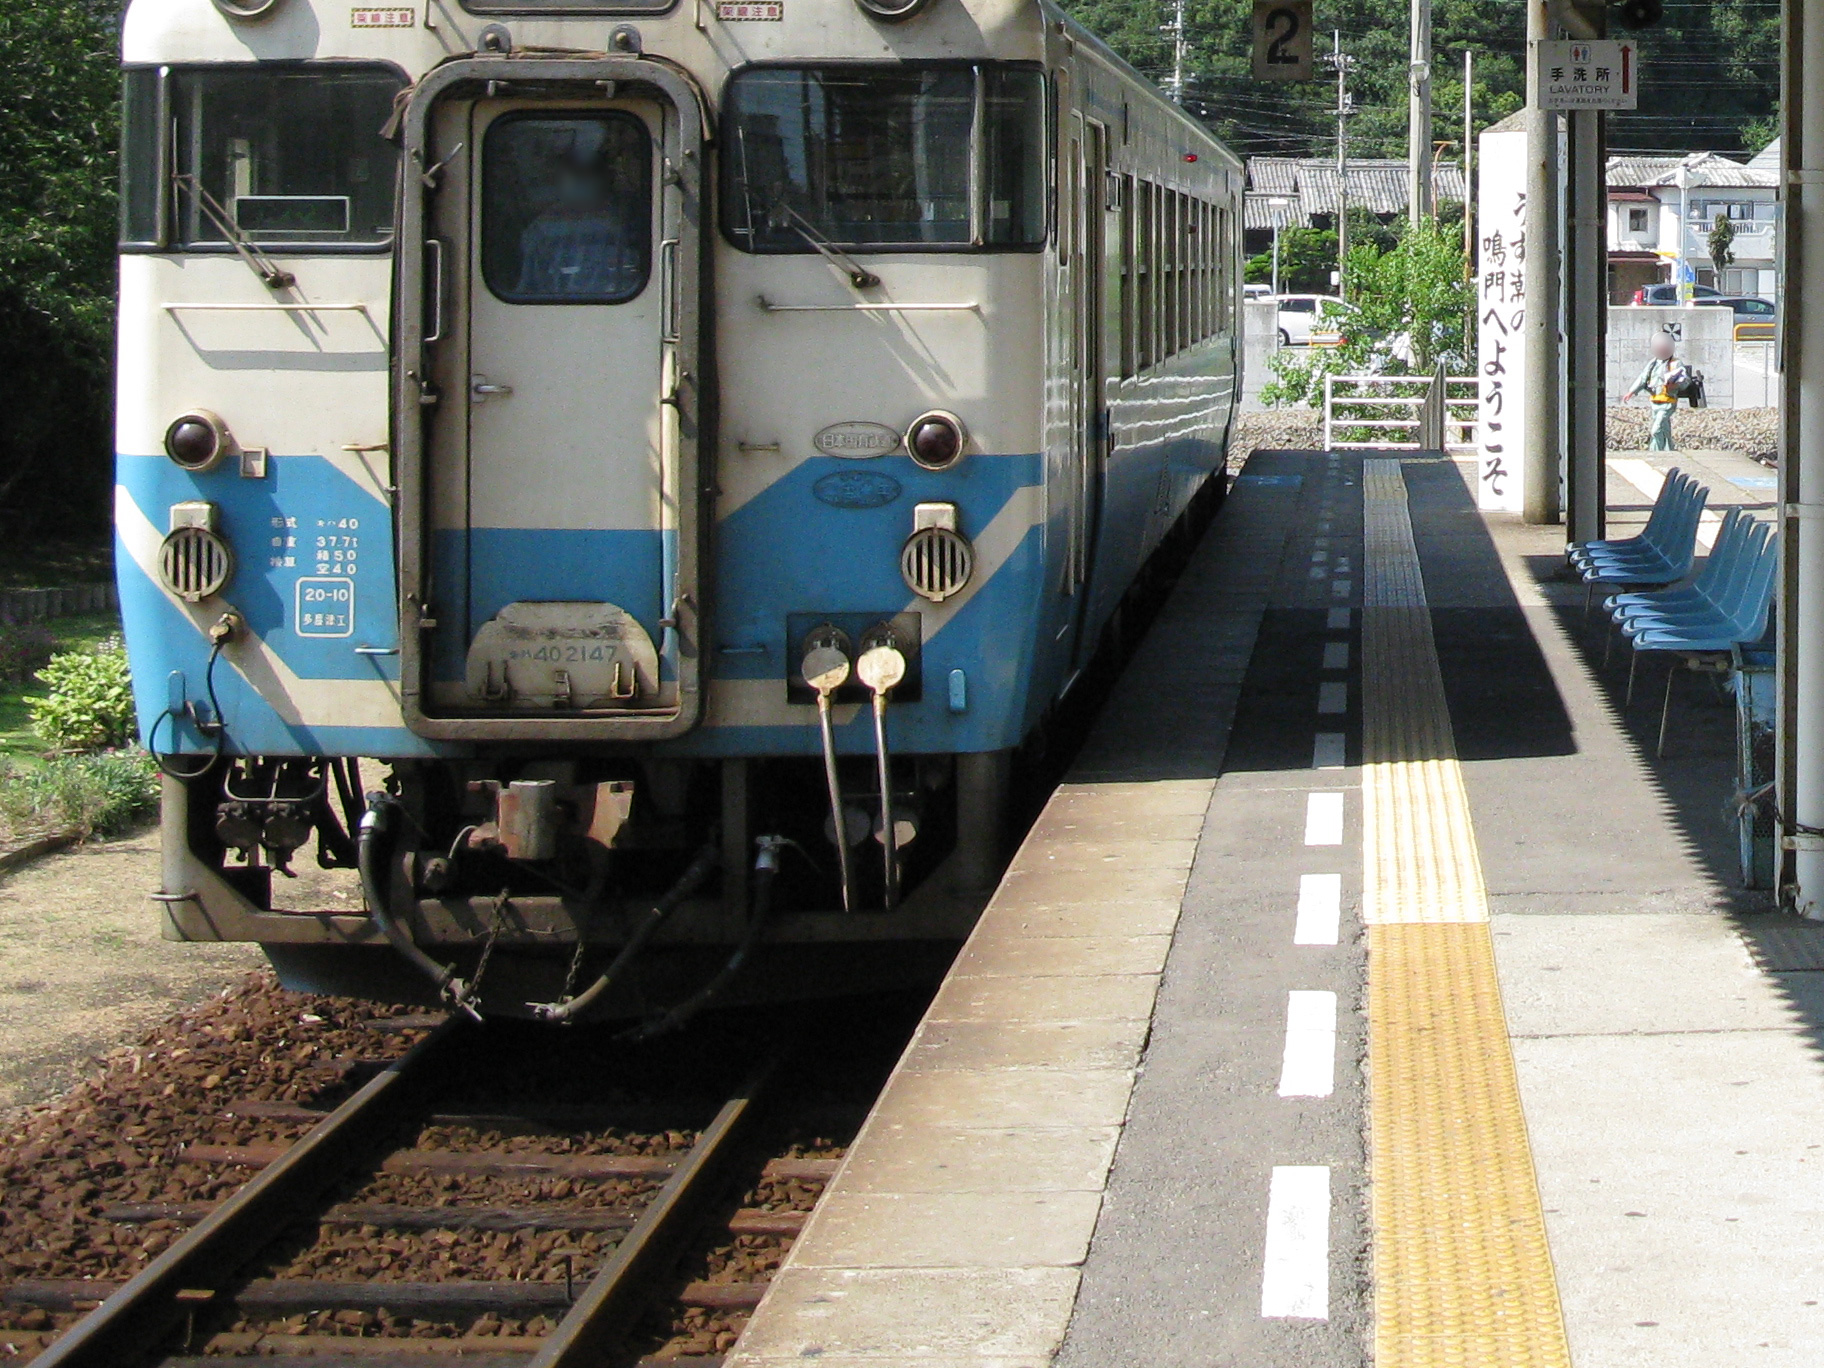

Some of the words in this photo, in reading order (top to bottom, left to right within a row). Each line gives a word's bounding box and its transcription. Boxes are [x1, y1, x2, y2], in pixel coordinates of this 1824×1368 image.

[1265, 10, 1299, 64] 2
[1550, 66, 1610, 83] 手洗所
[1549, 85, 1610, 95] LAVATORY
[1481, 228, 1509, 497] 鳴門へようこそ
[304, 588, 349, 602] 20-10
